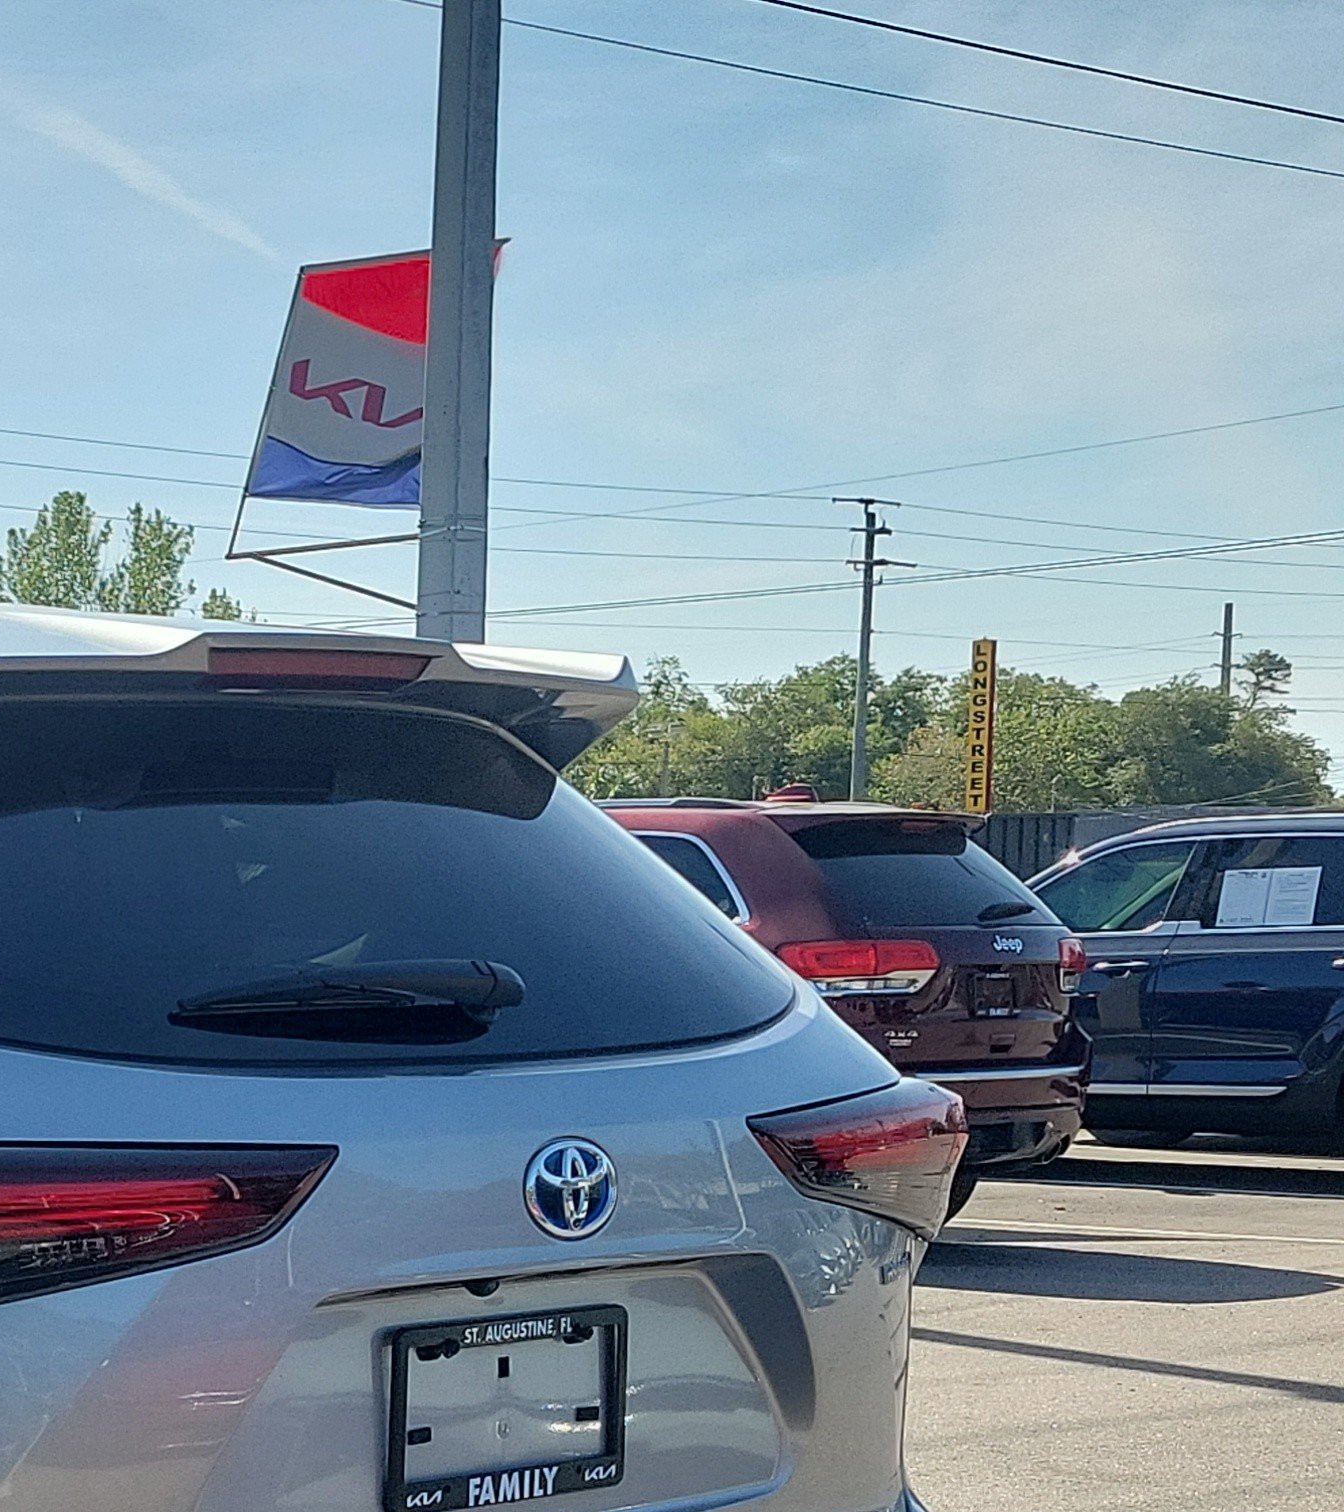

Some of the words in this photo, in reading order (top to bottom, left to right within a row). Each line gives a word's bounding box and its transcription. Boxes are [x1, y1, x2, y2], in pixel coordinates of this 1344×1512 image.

[968, 644, 988, 808] LONGSTREET
[992, 935, 1024, 954] Jeep
[464, 1327, 482, 1344] ST.
[485, 1318, 557, 1343] AUGUSTINE,
[560, 1316, 573, 1333] FL
[468, 1466, 559, 1507] FAMILY
